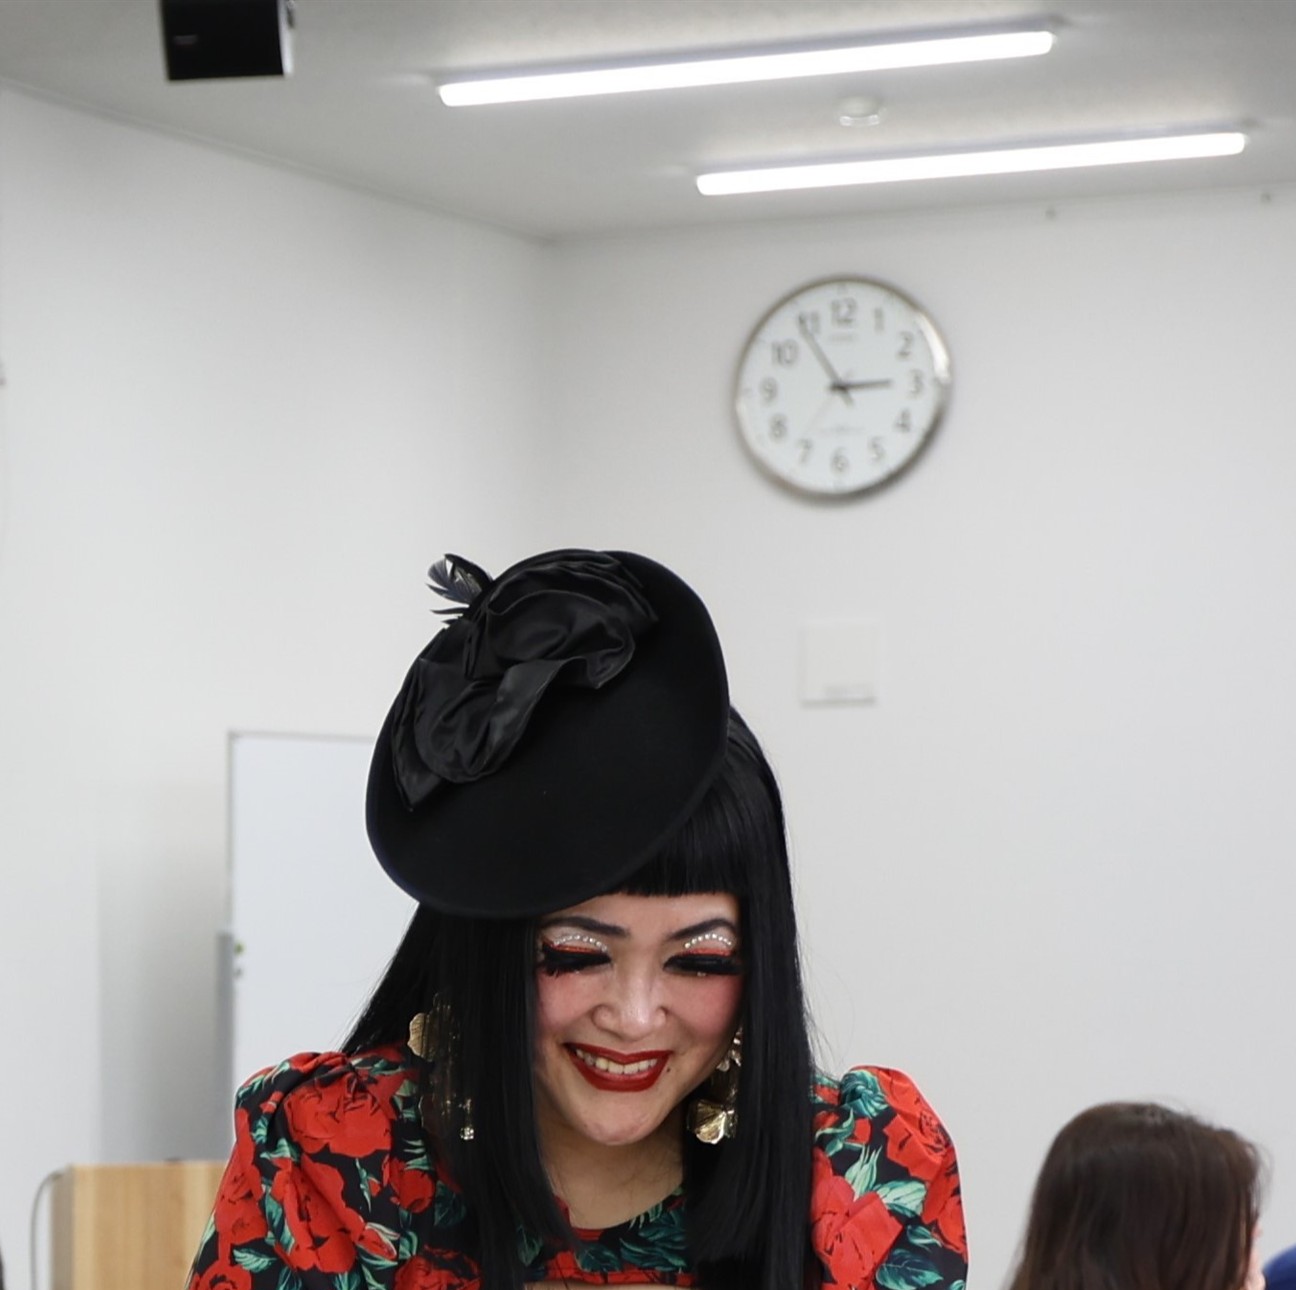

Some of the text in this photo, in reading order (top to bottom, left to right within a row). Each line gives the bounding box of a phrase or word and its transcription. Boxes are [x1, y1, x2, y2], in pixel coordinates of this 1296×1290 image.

[830, 299, 857, 323] 12
[874, 308, 884, 330] 1
[771, 341, 798, 365] 10
[898, 333, 914, 357] 2
[760, 377, 777, 402] 9
[910, 371, 925, 394] 3
[770, 415, 787, 439] 8
[894, 410, 912, 432] 4
[799, 440, 813, 462] 7
[831, 448, 848, 472] 6
[869, 439, 884, 460] 5
